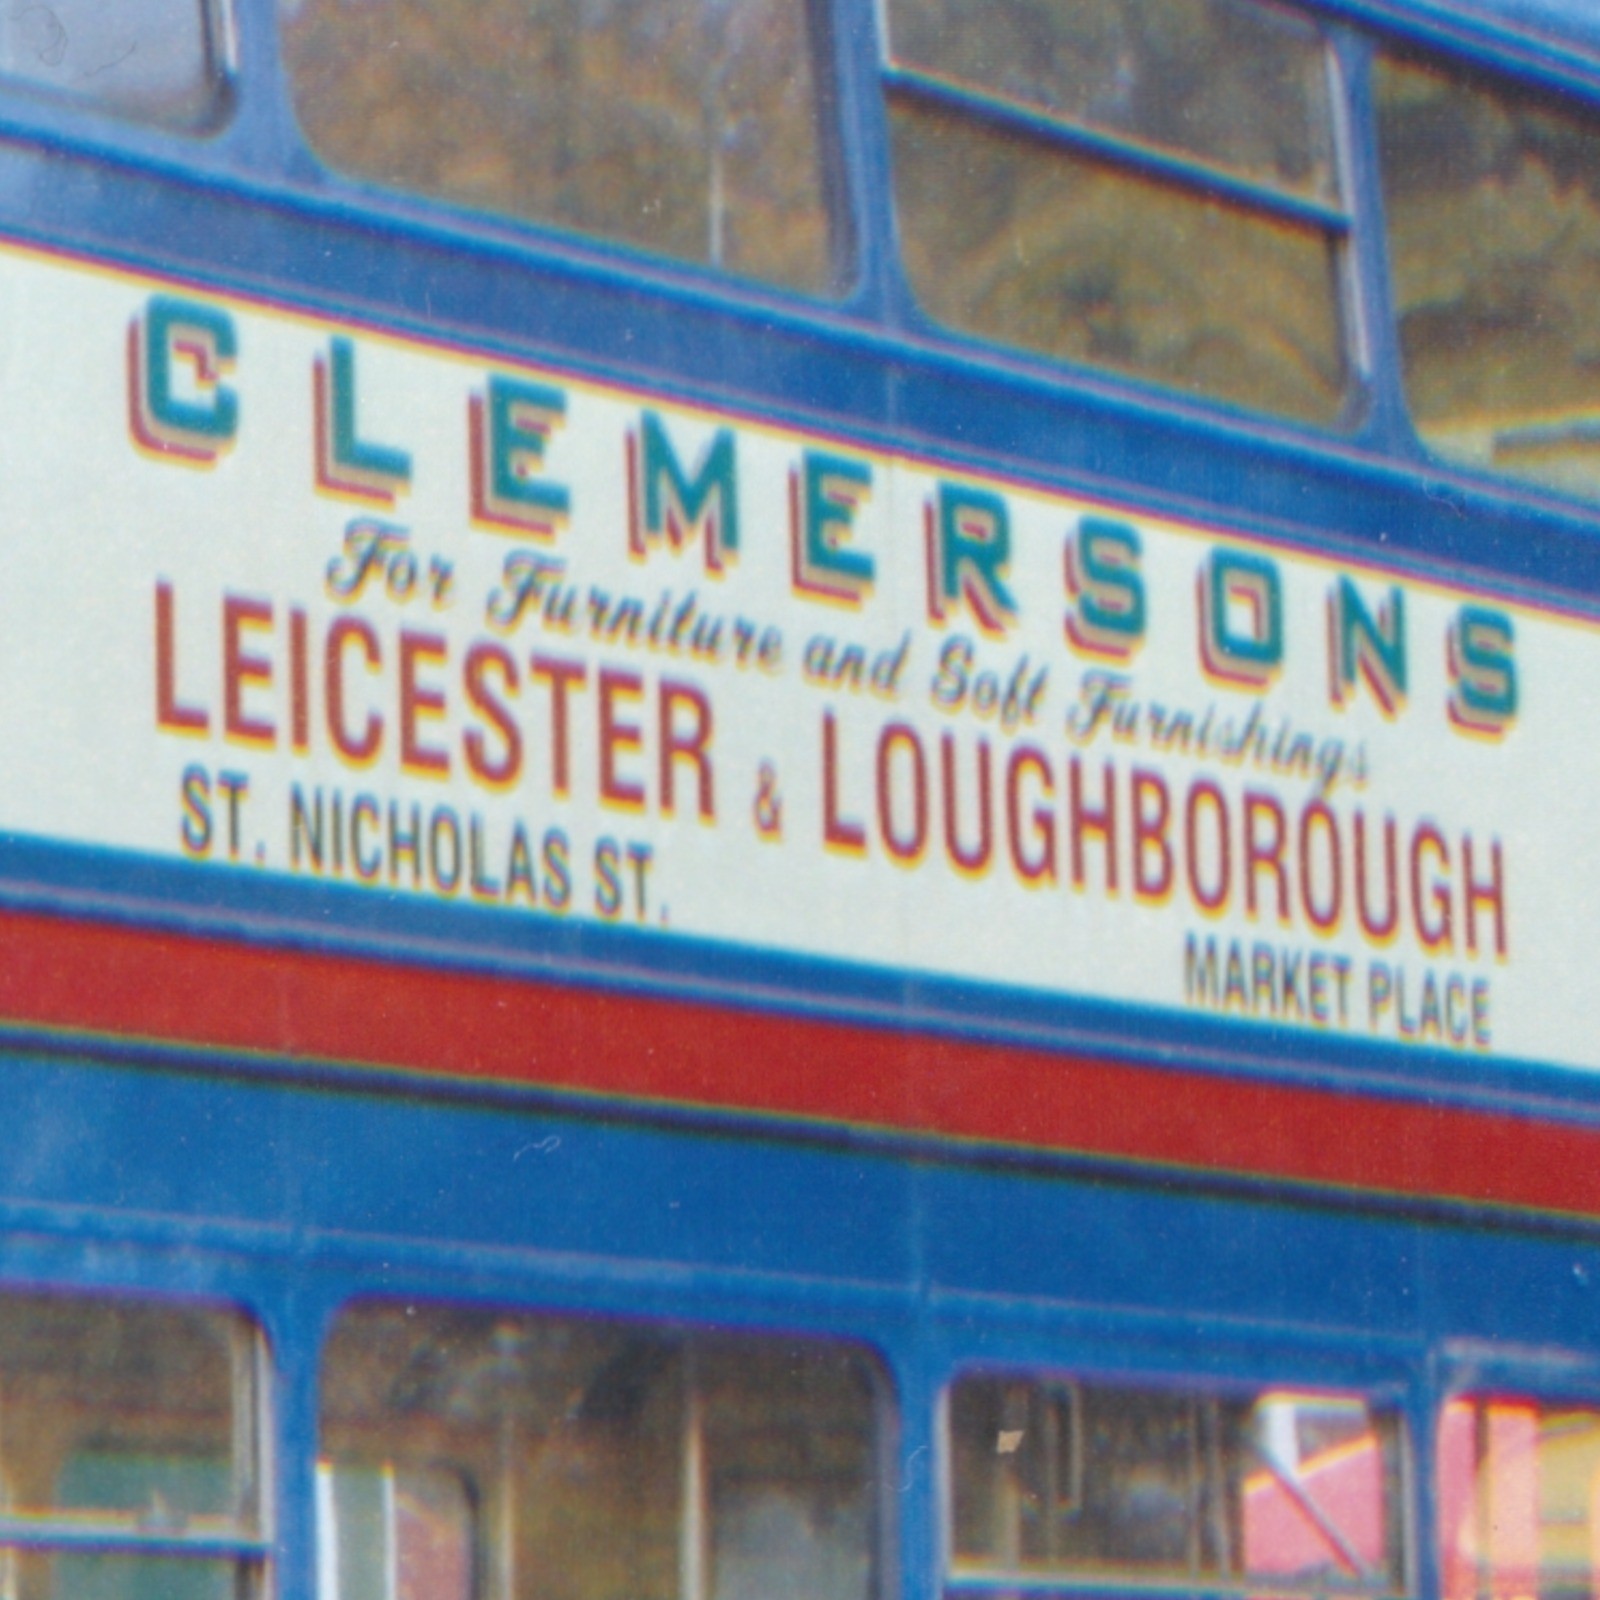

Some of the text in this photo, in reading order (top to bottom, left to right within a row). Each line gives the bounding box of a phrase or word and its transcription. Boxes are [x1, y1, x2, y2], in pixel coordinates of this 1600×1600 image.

[127, 294, 1519, 740] CLEMERSONS
[325, 516, 1369, 803] For Furniture and Soft Furnishings
[155, 578, 1509, 963] LEICESTER & LOUGHBOROUGH
[180, 763, 671, 927] ST. NICHOLAS ST.
[1184, 932, 1492, 1052] MARKET PLACE
